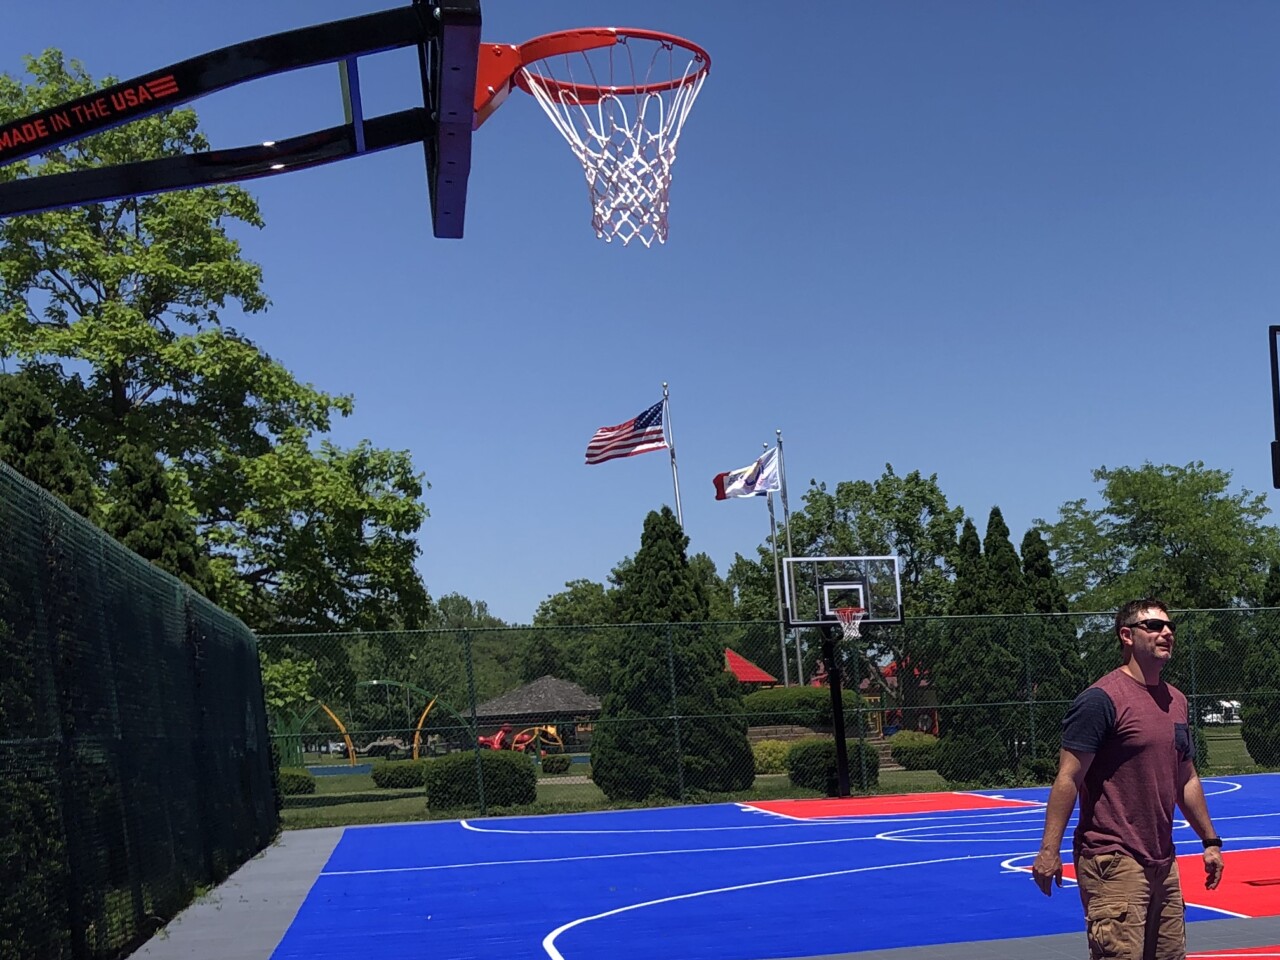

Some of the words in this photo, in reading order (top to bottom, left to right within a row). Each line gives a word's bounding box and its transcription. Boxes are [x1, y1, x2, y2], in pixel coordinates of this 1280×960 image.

[0, 120, 49, 151] MADE
[50, 111, 72, 132] IN
[71, 98, 112, 123] THE
[111, 85, 152, 111] USA
